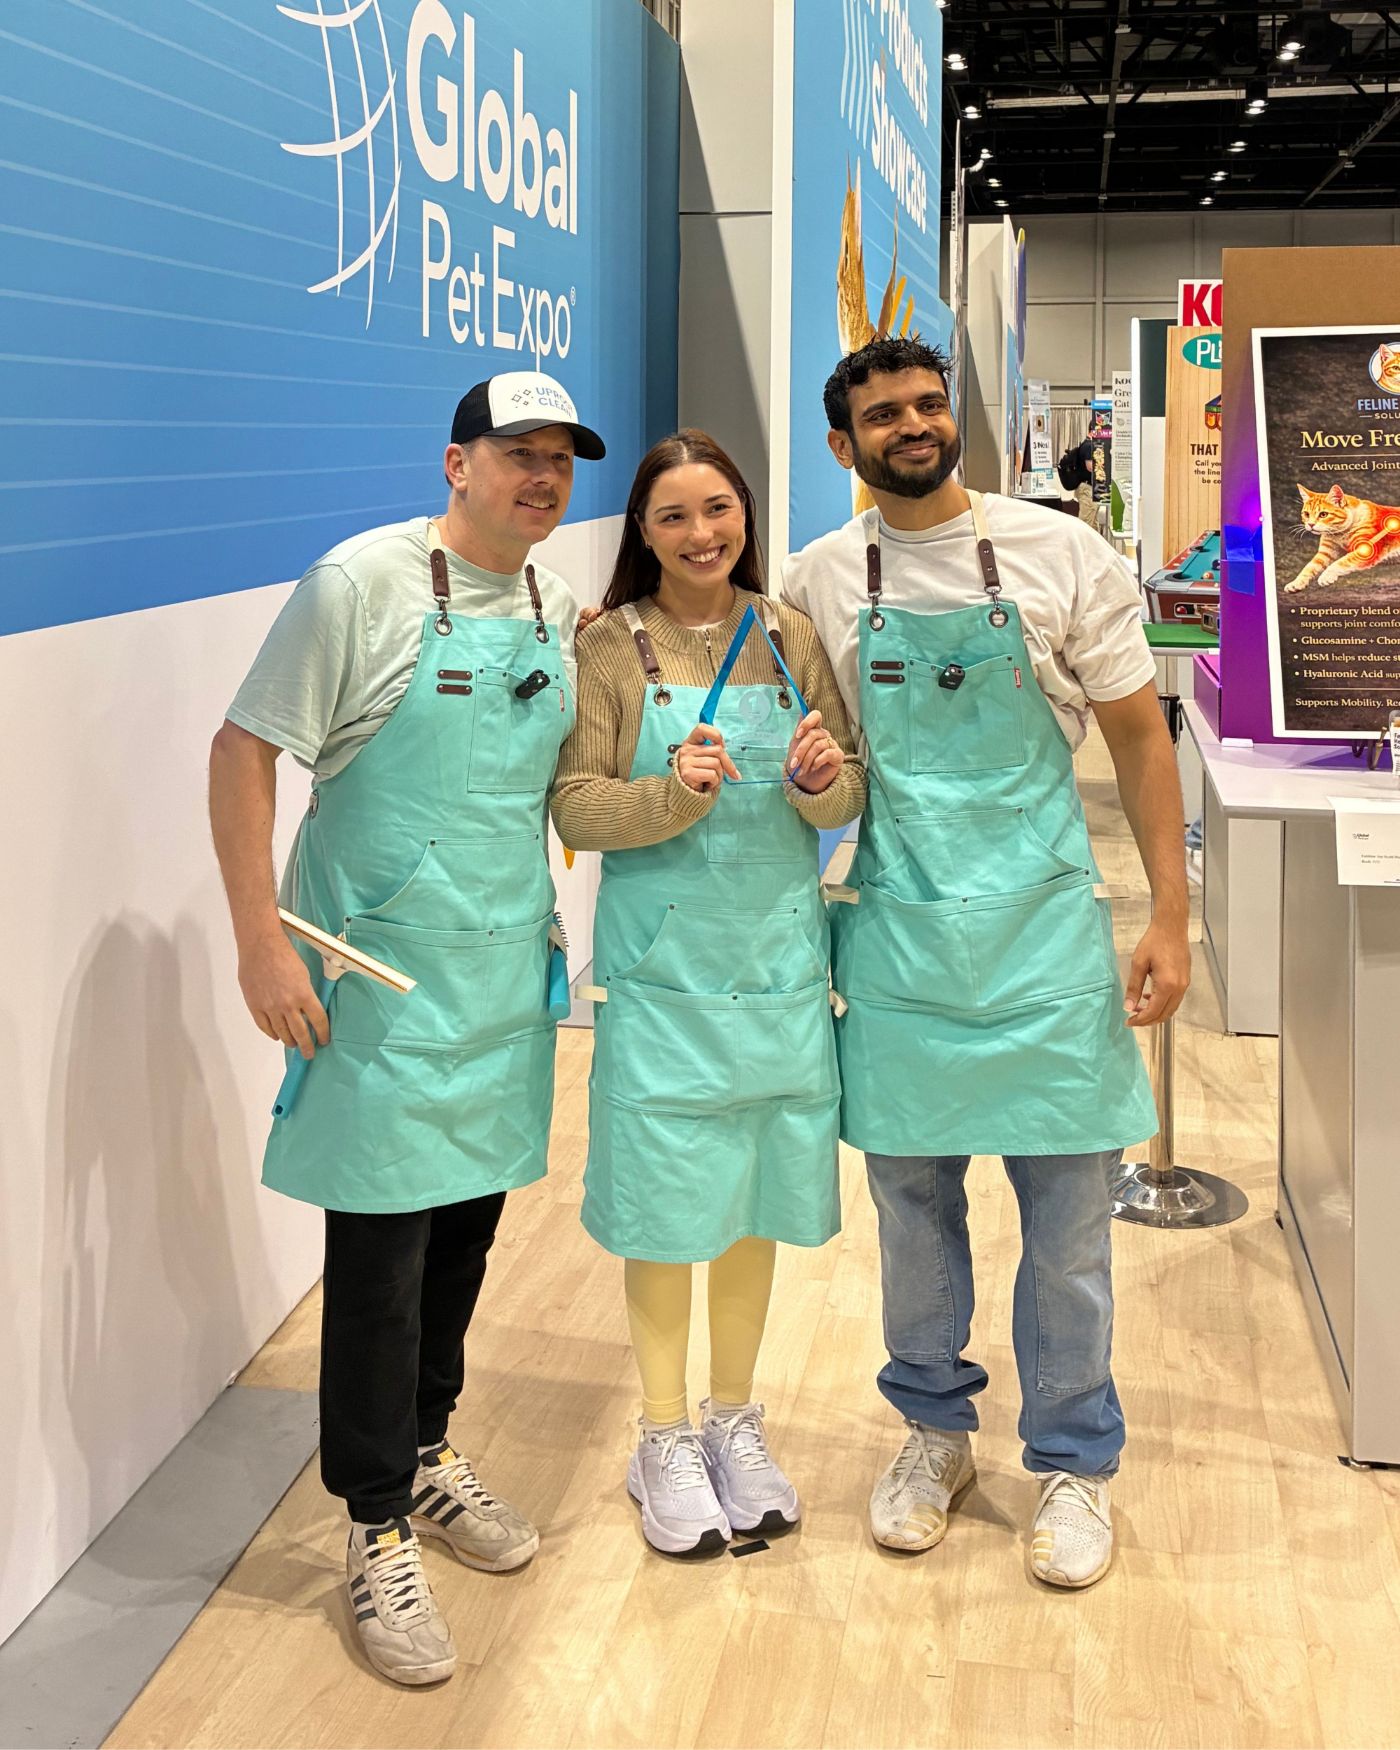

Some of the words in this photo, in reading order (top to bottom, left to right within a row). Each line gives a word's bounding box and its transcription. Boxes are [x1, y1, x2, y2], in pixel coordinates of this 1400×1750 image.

[406, 0, 578, 235] Global
[871, 60, 927, 235] Showcase
[422, 200, 485, 347] Pet
[1196, 339, 1222, 366] PL
[1357, 398, 1399, 411] FELINE
[1300, 430, 1364, 449] Move
[1190, 443, 1219, 456] THAT
[1311, 460, 1369, 472] Advanced
[1371, 460, 1400, 472] Joint
[1300, 606, 1360, 618] Proprietary
[1361, 606, 1391, 616] blend
[1300, 620, 1342, 630] supports
[1344, 619, 1367, 629] joint
[1301, 636, 1367, 645] Glucosamine
[1302, 653, 1330, 662] MSM
[1331, 653, 1356, 663] helps
[1357, 652, 1391, 662] reduce
[1303, 669, 1358, 680] Hyaluronic
[1360, 669, 1384, 679] Acid
[1295, 698, 1339, 709] Supports
[1341, 698, 1384, 709] Mobility.
